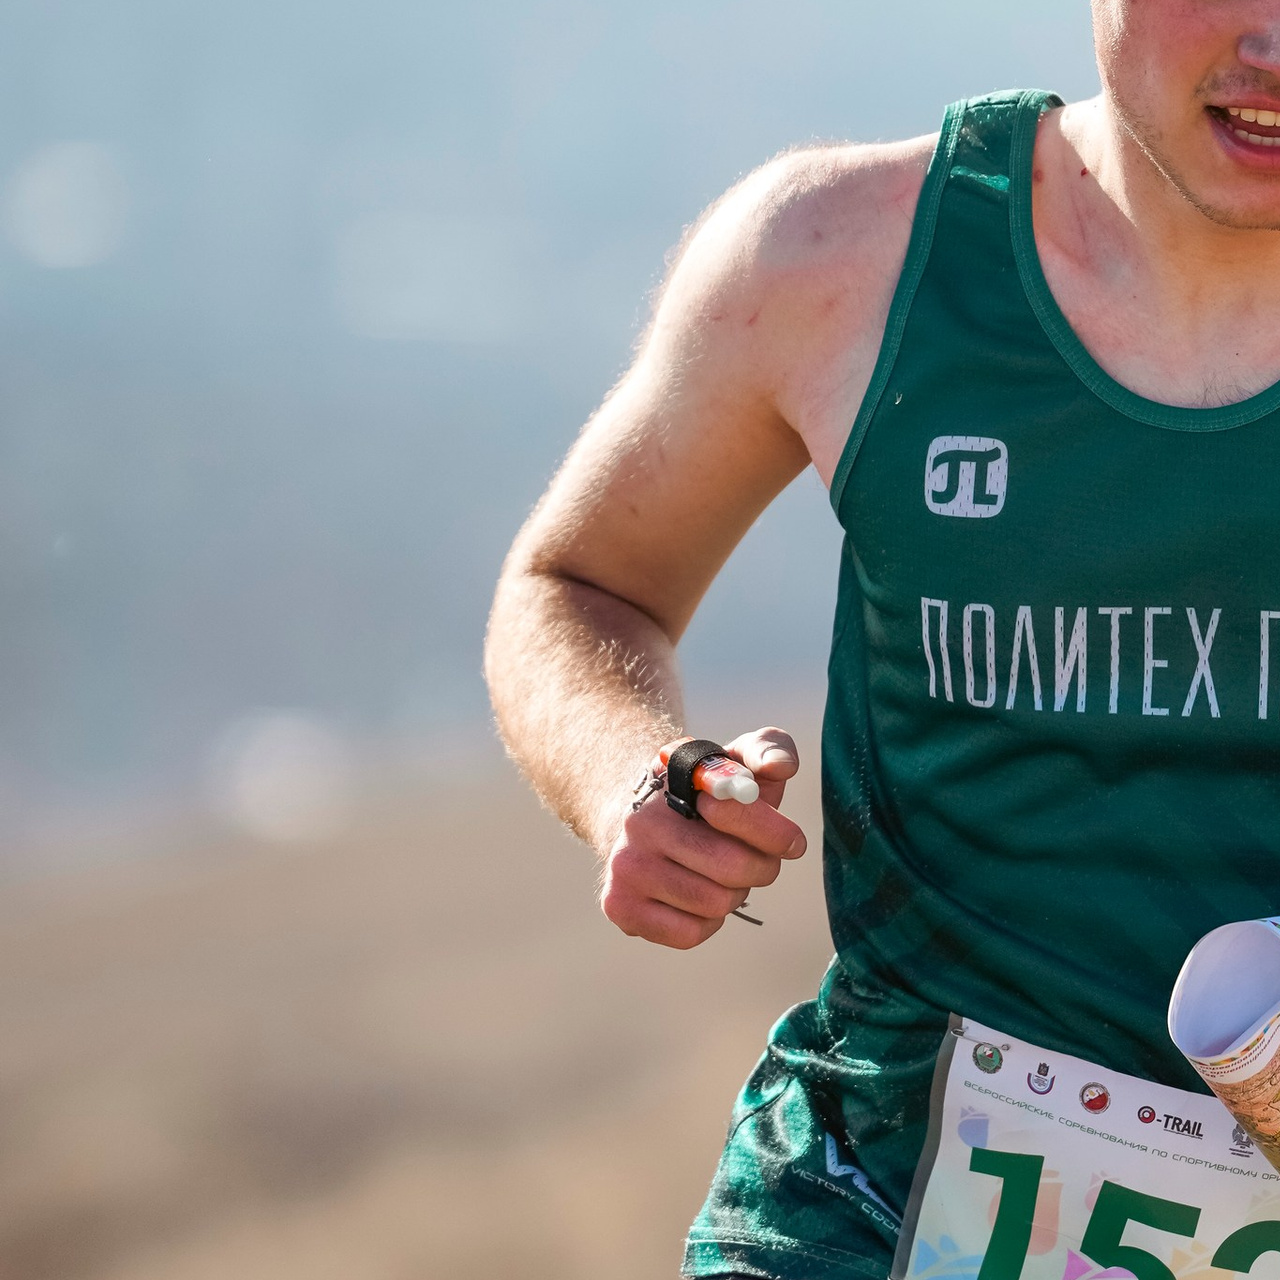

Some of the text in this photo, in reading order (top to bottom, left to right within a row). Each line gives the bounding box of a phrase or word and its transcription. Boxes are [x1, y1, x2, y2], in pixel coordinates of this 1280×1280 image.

[920, 596, 1223, 719] ПОЛИТЕХ
[963, 1079, 1055, 1121] ВСЕРОССИЙСКИЕ
[1058, 1116, 1149, 1153] СОРЕВНОВАНИЯ
[1151, 1148, 1169, 1159] ПО
[1172, 1153, 1258, 1179] СПОРТИВНОМУ
[791, 1164, 856, 1201] VICTORY
